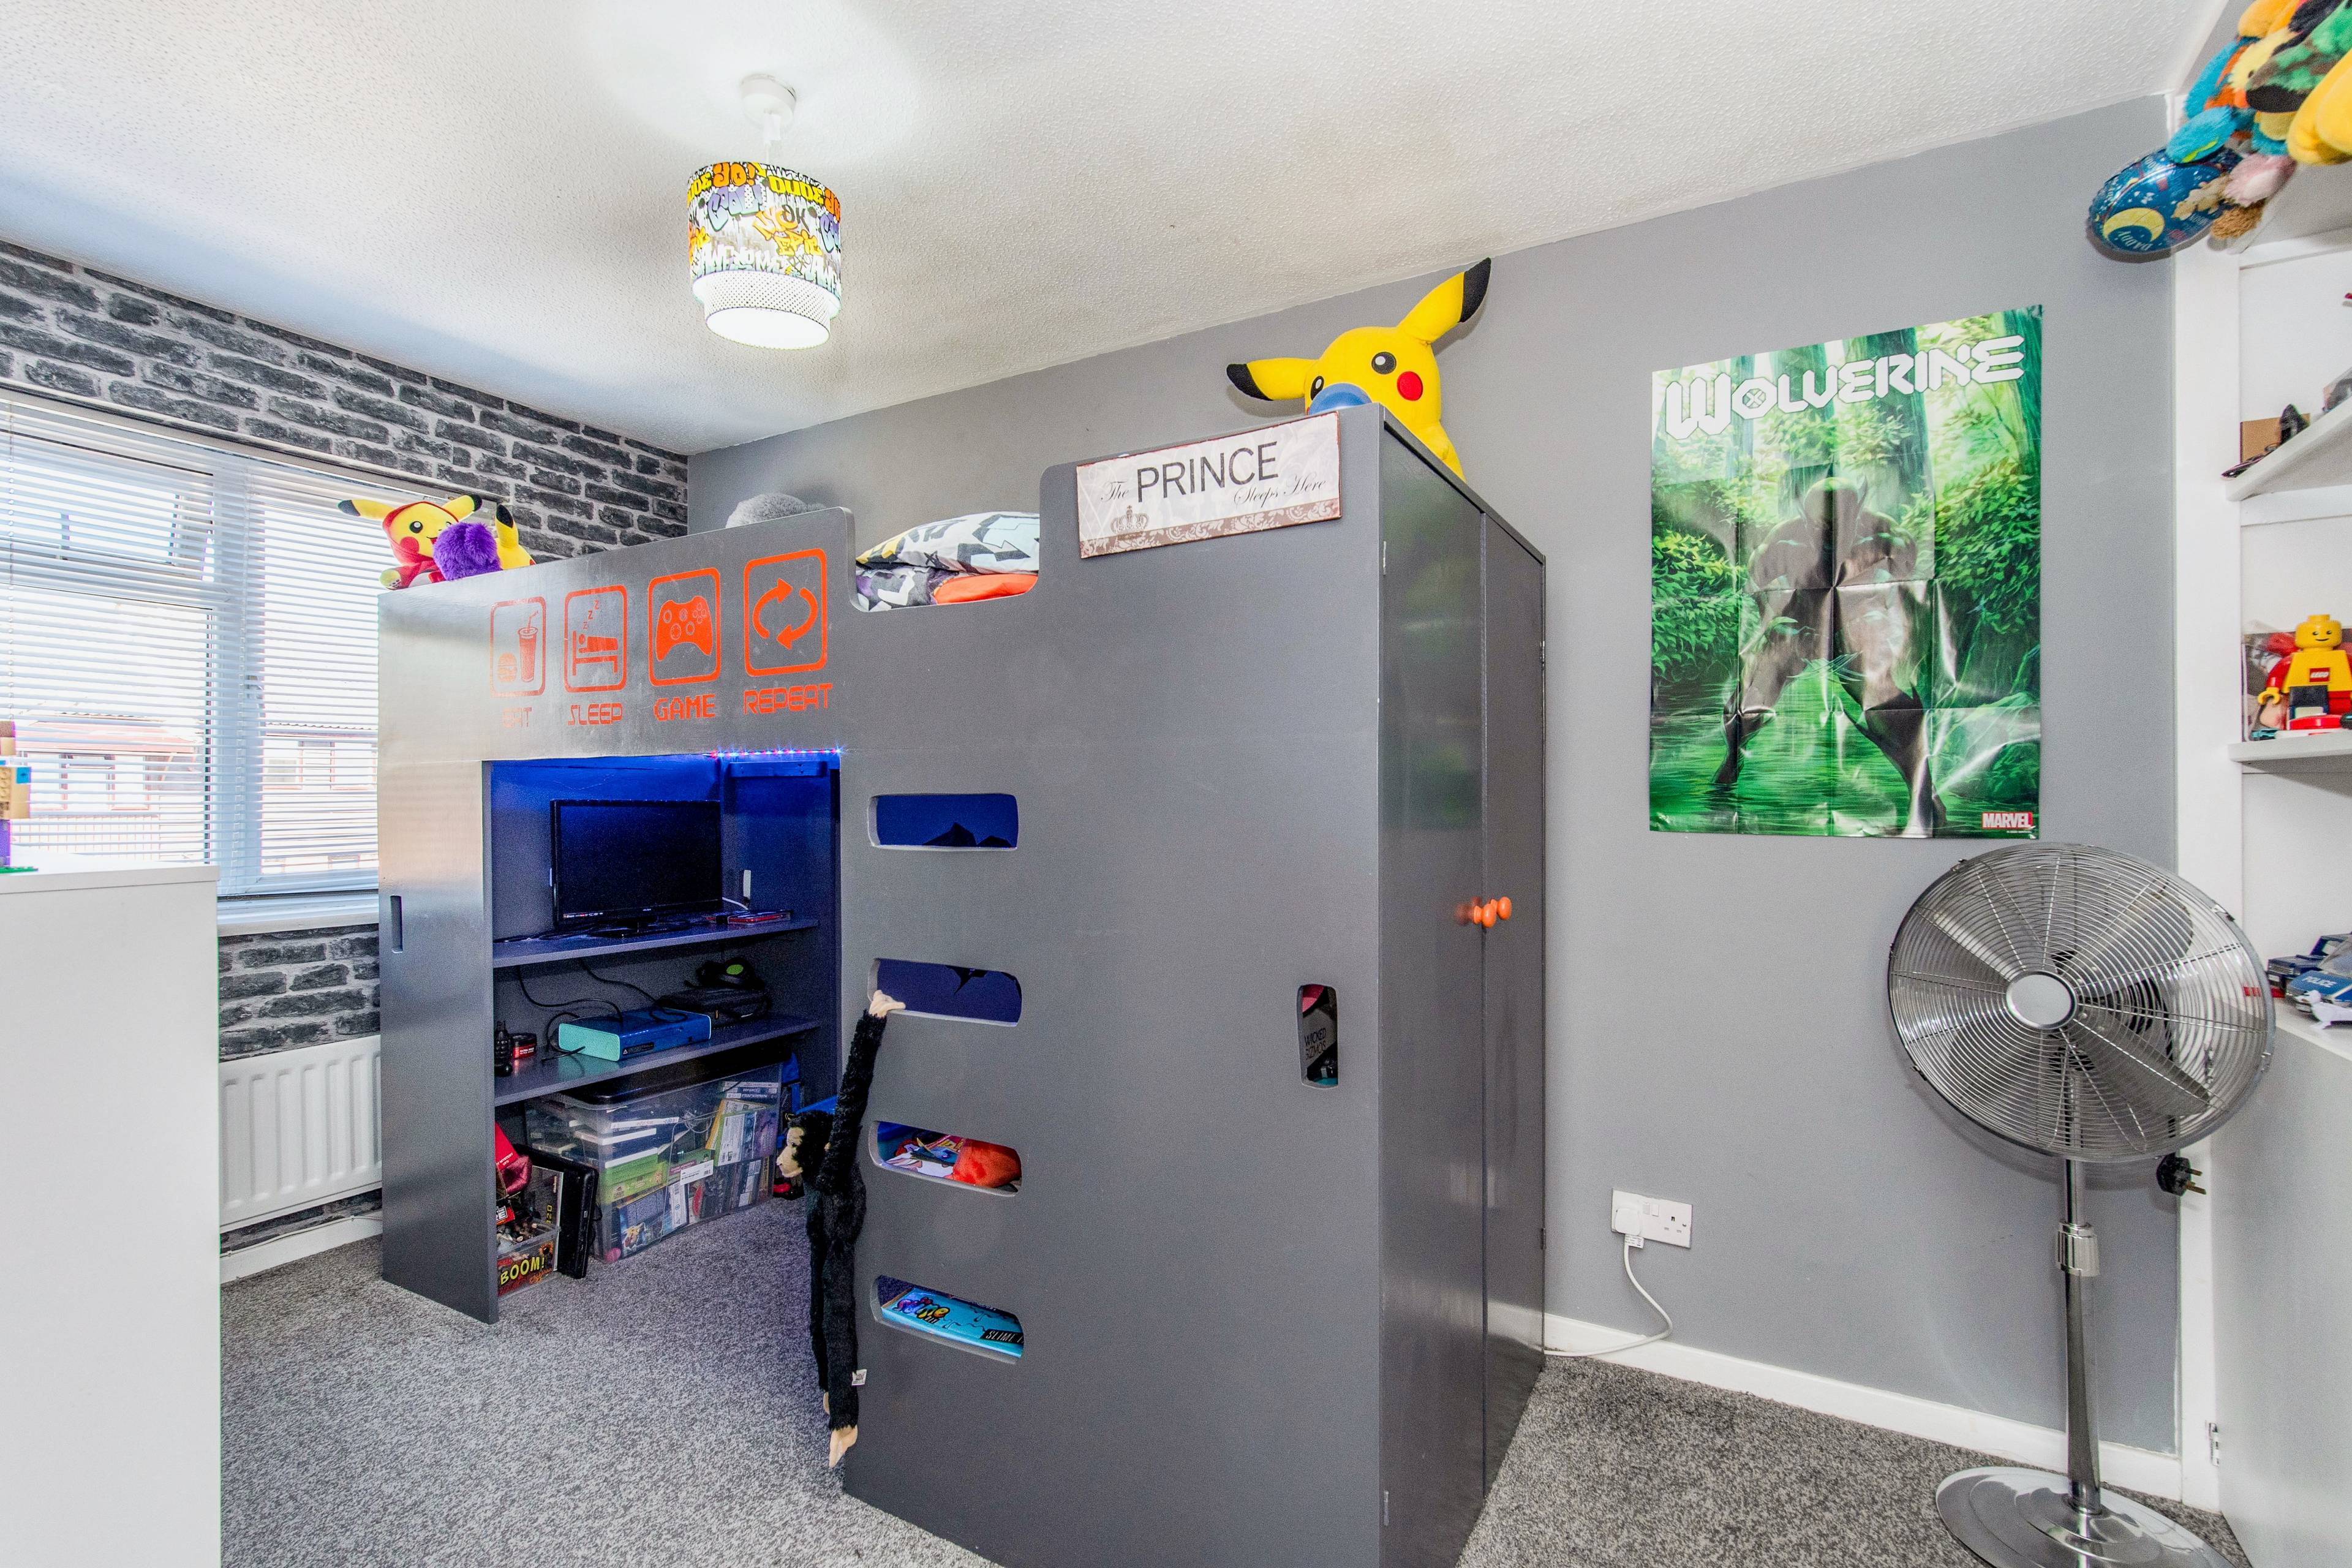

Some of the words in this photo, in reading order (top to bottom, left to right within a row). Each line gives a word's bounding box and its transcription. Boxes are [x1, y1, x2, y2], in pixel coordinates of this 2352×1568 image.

[768, 175, 824, 206] DUDE
[1665, 334, 2024, 440] WOLVERINE
[1101, 481, 1129, 501] The
[1137, 441, 1279, 503] PRINCE
[1234, 489, 1279, 508] Sleeps
[1283, 472, 1327, 496] Here
[653, 694, 716, 722] GAME
[744, 684, 833, 714] REPEAT
[502, 707, 532, 728] EAT
[568, 703, 623, 726] SLEEP
[1983, 812, 2030, 828] MARVEL
[2301, 976, 2337, 987] POLICE
[500, 1256, 545, 1285] BOOM!
